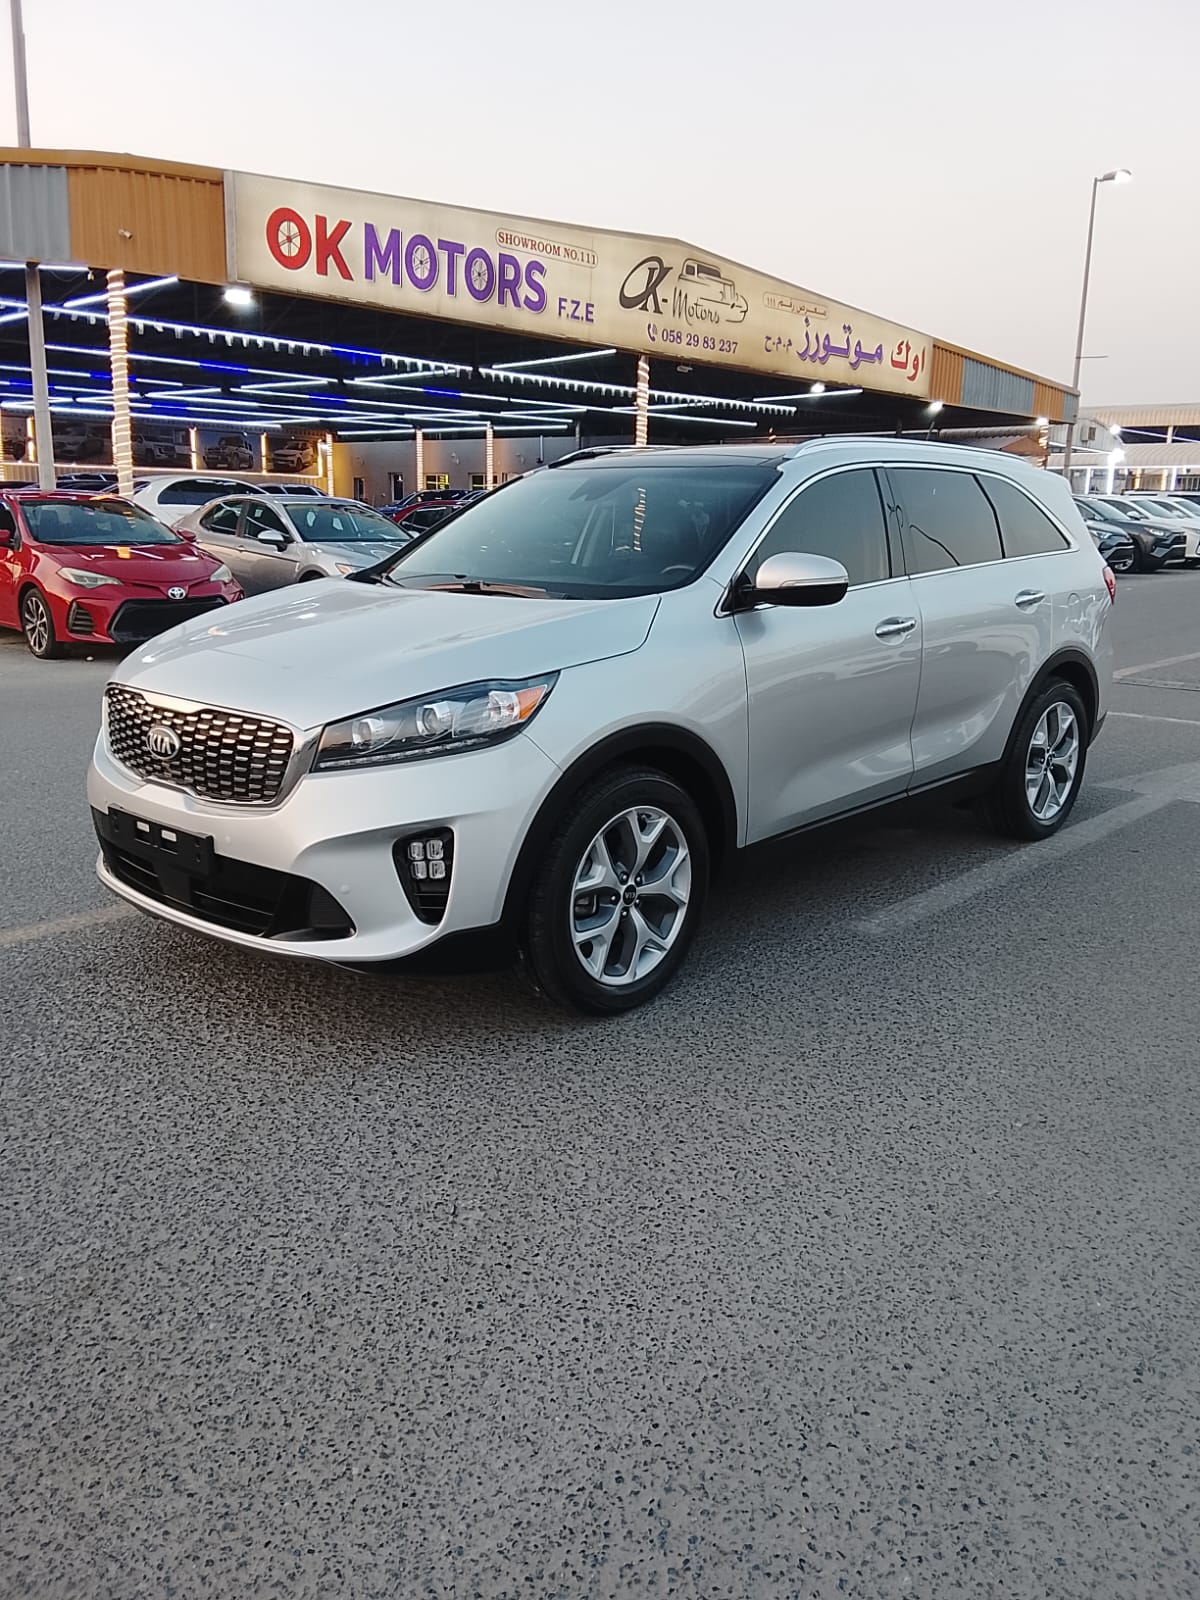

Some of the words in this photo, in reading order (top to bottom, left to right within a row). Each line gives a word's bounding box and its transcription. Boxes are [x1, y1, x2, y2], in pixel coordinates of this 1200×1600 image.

[265, 206, 354, 282] OK
[363, 222, 547, 313] MOTORS
[558, 296, 595, 323] F.Z.E
[498, 230, 561, 257] SHOWROOM
[563, 247, 596, 265] NO.111
[661, 328, 683, 345] 058
[685, 332, 700, 348] 29
[702, 335, 716, 351] 83
[718, 338, 739, 355] 237
[796, 316, 884, 371] موتورز
[149, 732, 172, 755] KIA
